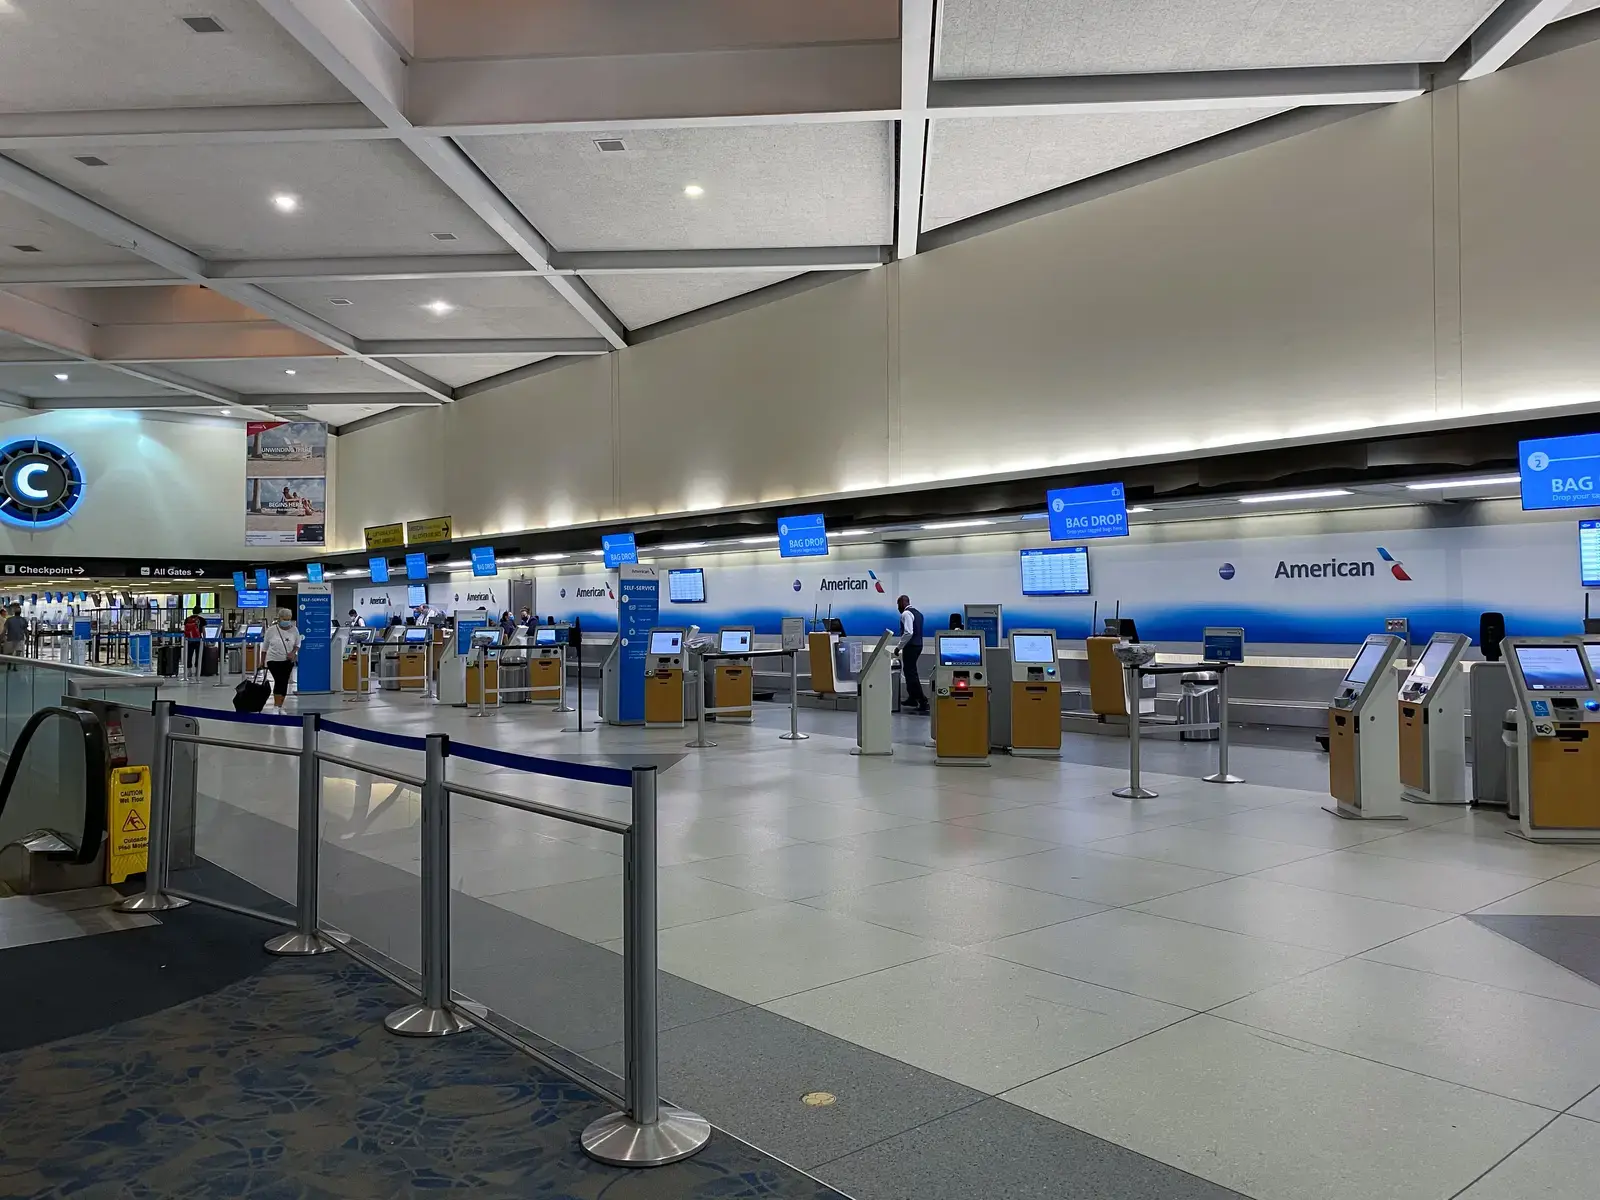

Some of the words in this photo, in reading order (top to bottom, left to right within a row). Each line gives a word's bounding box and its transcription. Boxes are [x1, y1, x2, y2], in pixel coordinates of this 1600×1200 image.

[1535, 460, 1542, 469] 2
[17, 462, 50, 498] C
[1551, 476, 1594, 493] BAG
[1552, 494, 1572, 502] Drop
[1572, 493, 1590, 502] your
[1065, 516, 1089, 529] BAG
[1091, 514, 1123, 527] DROP
[789, 539, 804, 548] BAG
[805, 538, 824, 547] DROP
[610, 553, 622, 561] BAG
[623, 552, 635, 560] DROP
[19, 565, 73, 575] Checkpoint
[153, 568, 165, 576] All
[167, 568, 191, 577] Gates
[1274, 558, 1375, 579] American
[820, 577, 868, 591] American
[466, 592, 490, 602] American
[576, 587, 606, 598] American
[369, 596, 387, 605] American
[123, 836, 147, 844] Cuidado
